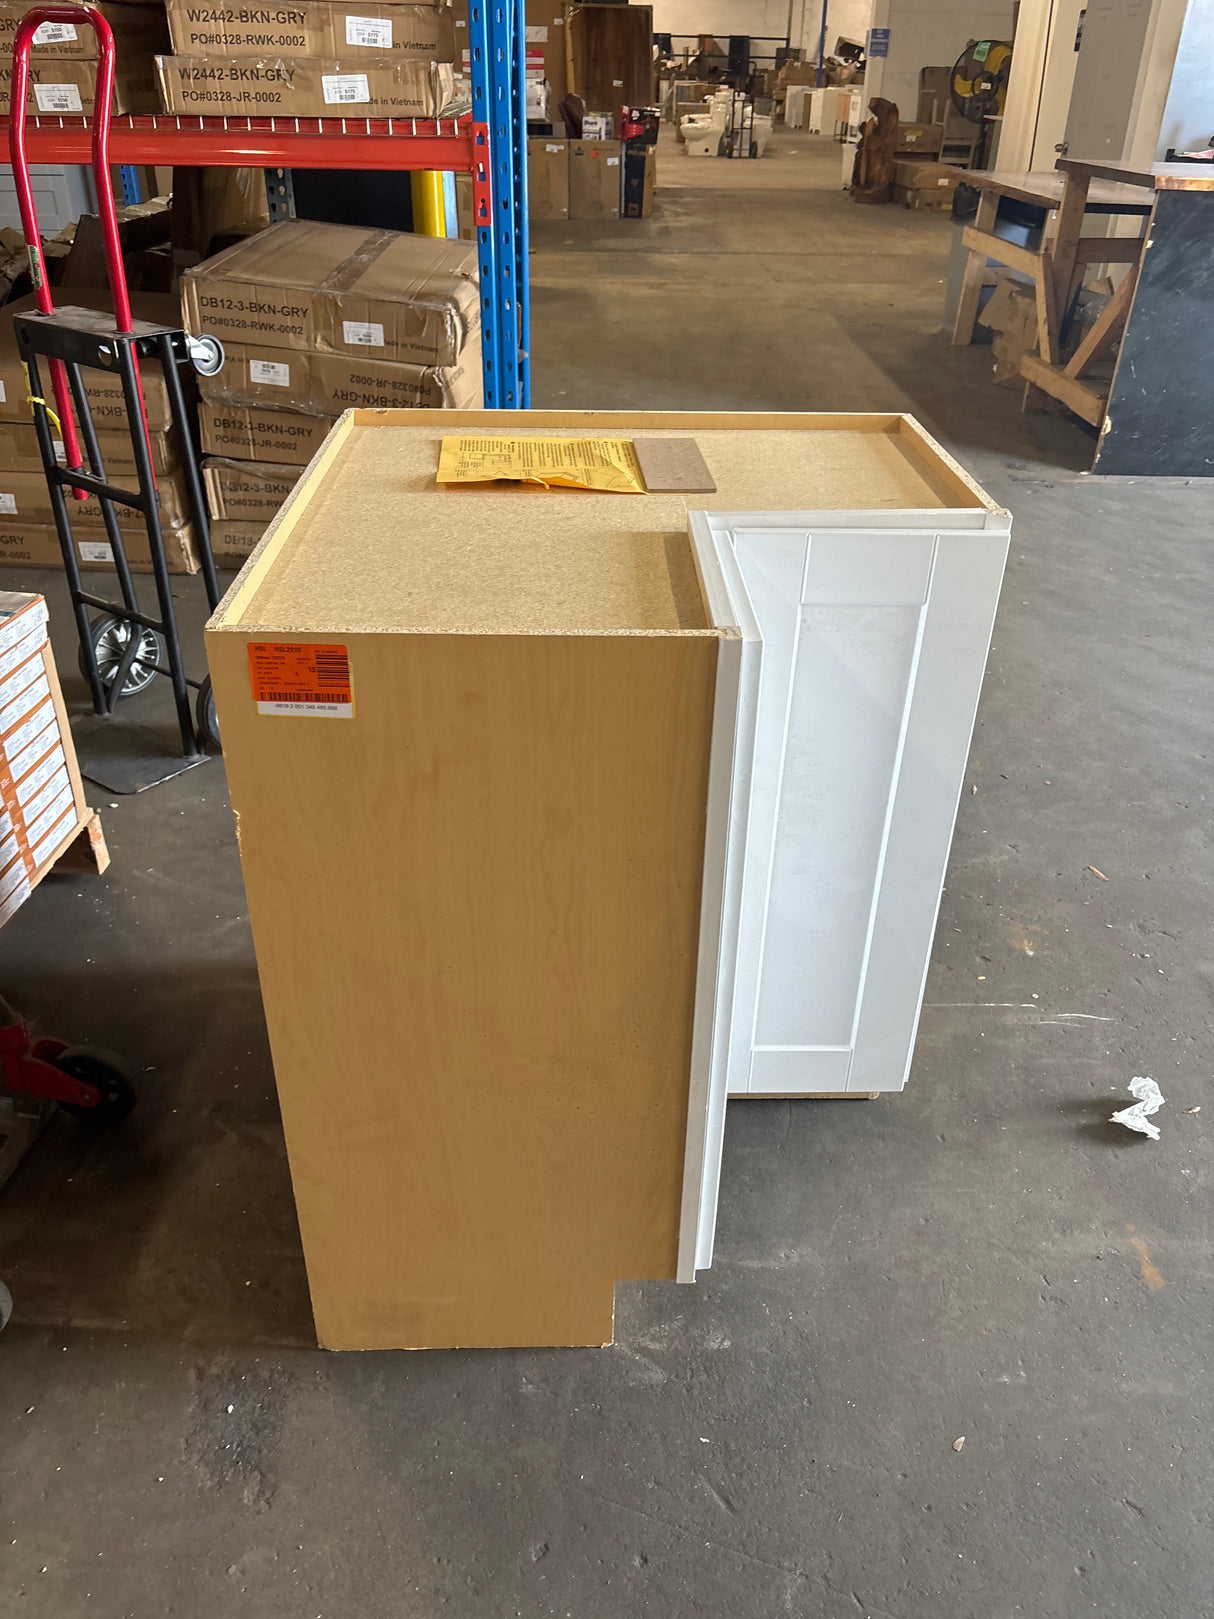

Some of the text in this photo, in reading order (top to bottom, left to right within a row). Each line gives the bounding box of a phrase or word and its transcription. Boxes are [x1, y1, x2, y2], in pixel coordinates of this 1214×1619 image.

[187, 9, 306, 25] W2442-BKN-GRY
[190, 33, 306, 47] PO#0328-RWK-0002
[403, 41, 436, 50] Vietnam
[178, 68, 295, 81] W2442-BKN-GRY
[182, 91, 282, 102] PO#0328-JR-0002
[368, 97, 378, 105] de
[390, 97, 423, 106] Vietnam
[200, 296, 309, 318] DB12-3-BKN-GRY
[202, 316, 304, 335] PO#0328-RWK-0002
[213, 418, 313, 438] DB12-3-BKN-GRY
[215, 435, 299, 451] PO#0328-JR-0002
